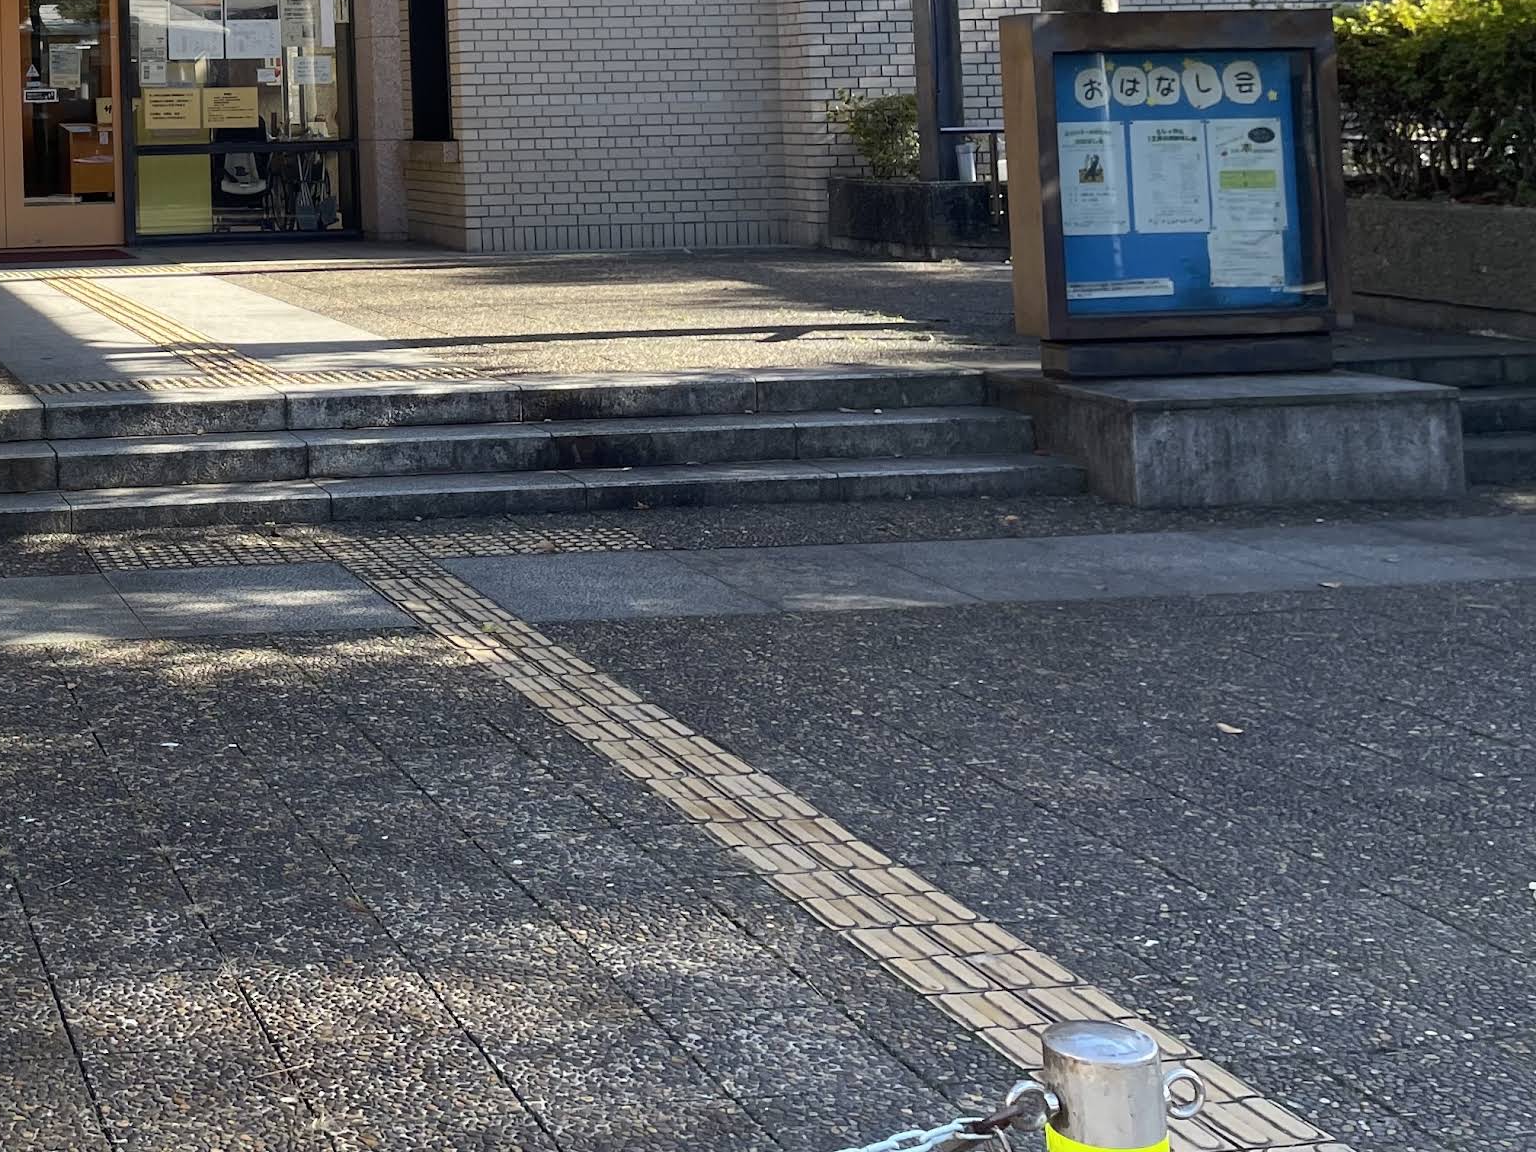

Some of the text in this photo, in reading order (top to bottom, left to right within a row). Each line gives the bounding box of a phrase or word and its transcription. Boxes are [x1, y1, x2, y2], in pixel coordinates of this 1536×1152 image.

[1081, 71, 1256, 102] おはなし会
